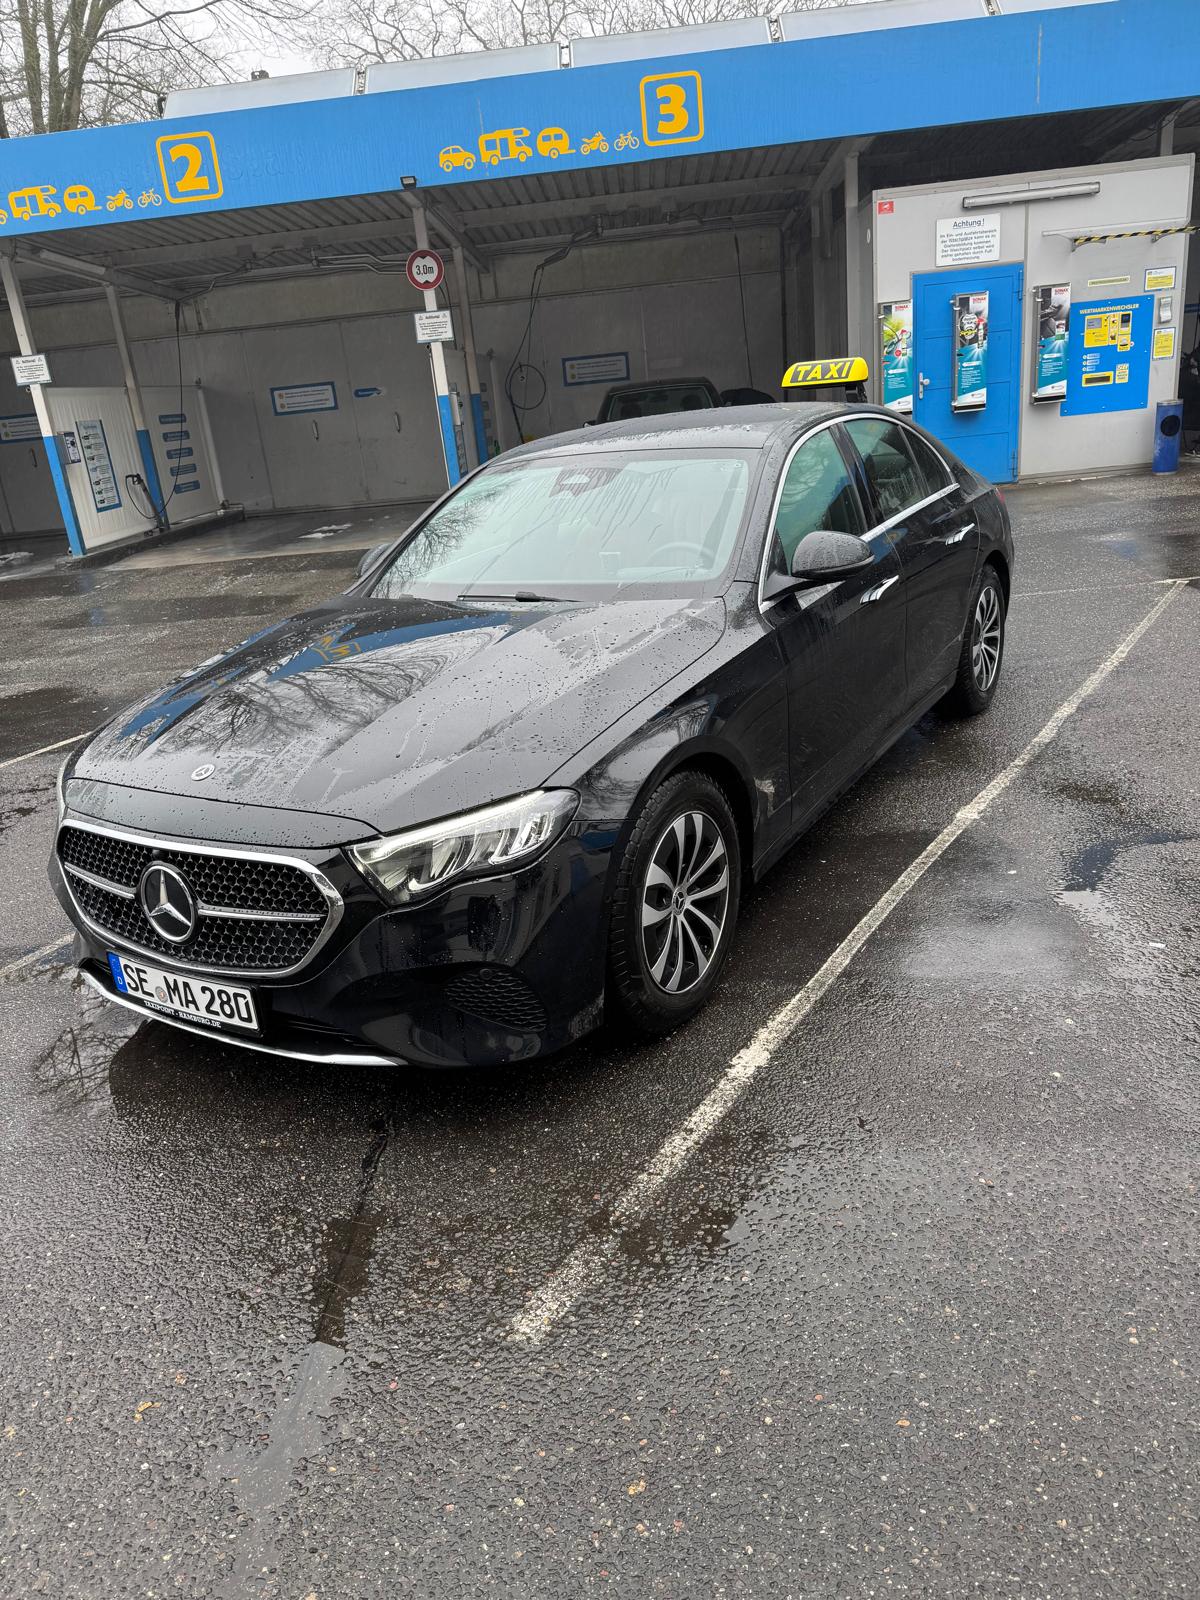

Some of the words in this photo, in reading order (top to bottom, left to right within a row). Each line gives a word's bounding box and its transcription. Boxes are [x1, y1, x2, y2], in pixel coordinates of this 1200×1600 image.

[656, 84, 689, 135] 3
[168, 143, 210, 193] 2
[796, 361, 851, 382] TAXI
[122, 963, 155, 998] SE
[163, 975, 200, 1012] MA
[200, 985, 253, 1023] 280
